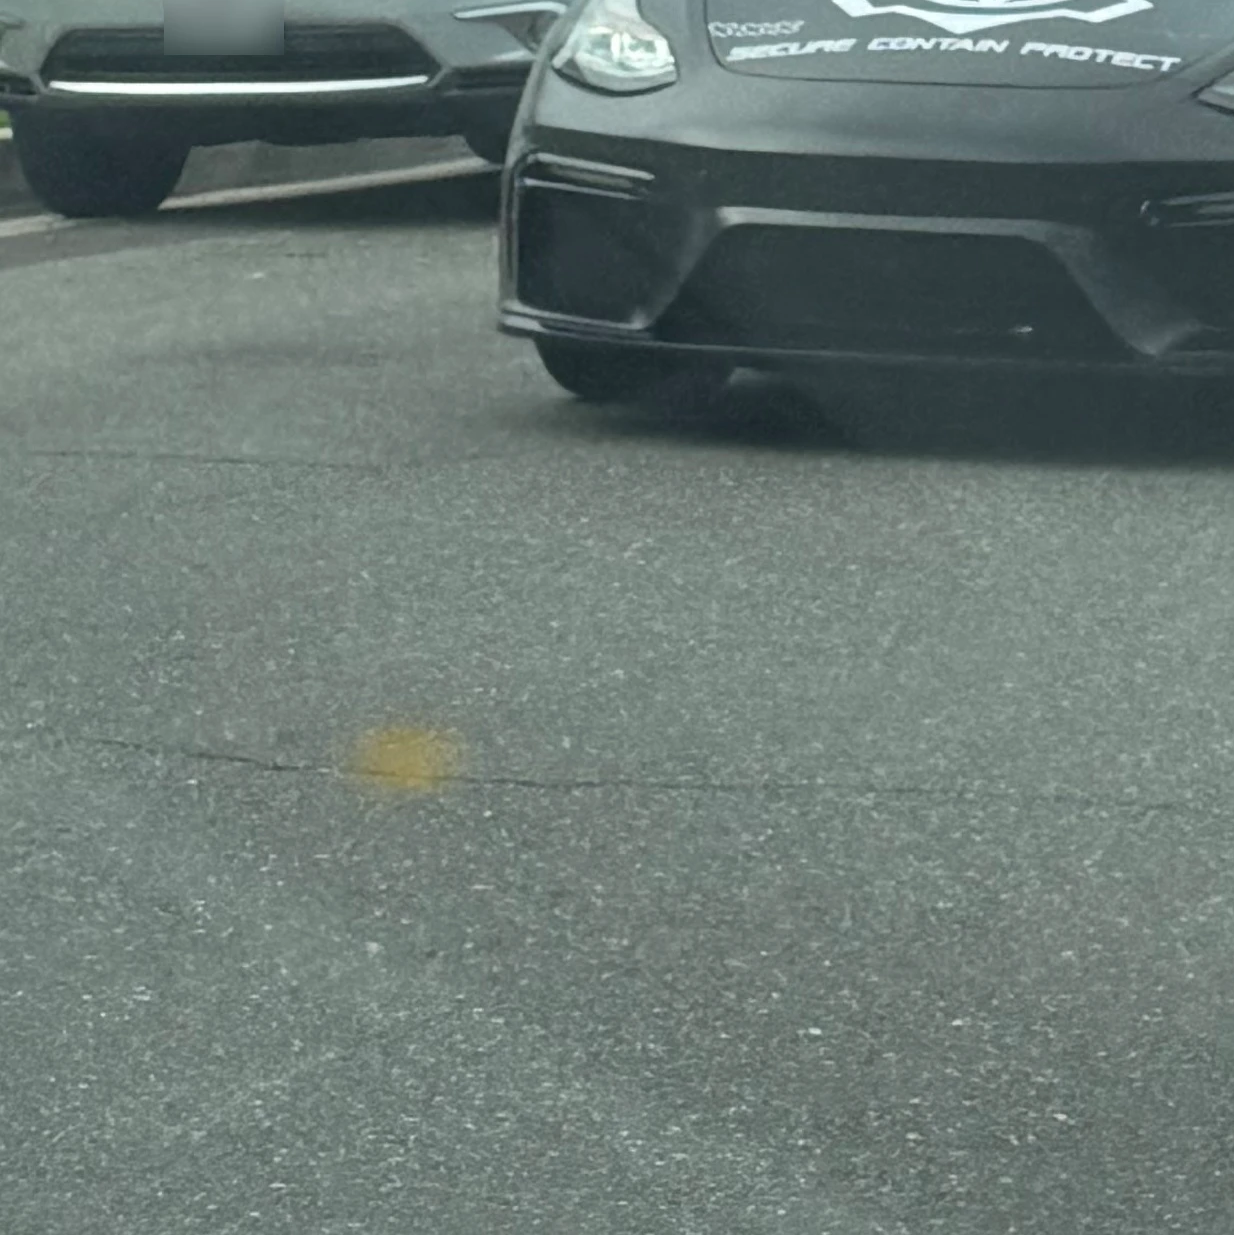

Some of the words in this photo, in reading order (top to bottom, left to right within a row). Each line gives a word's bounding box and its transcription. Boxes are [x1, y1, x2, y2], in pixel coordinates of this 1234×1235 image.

[726, 38, 858, 62] SECURE
[867, 37, 1010, 54] CONTAIN
[1019, 41, 1182, 72] PROTECT
